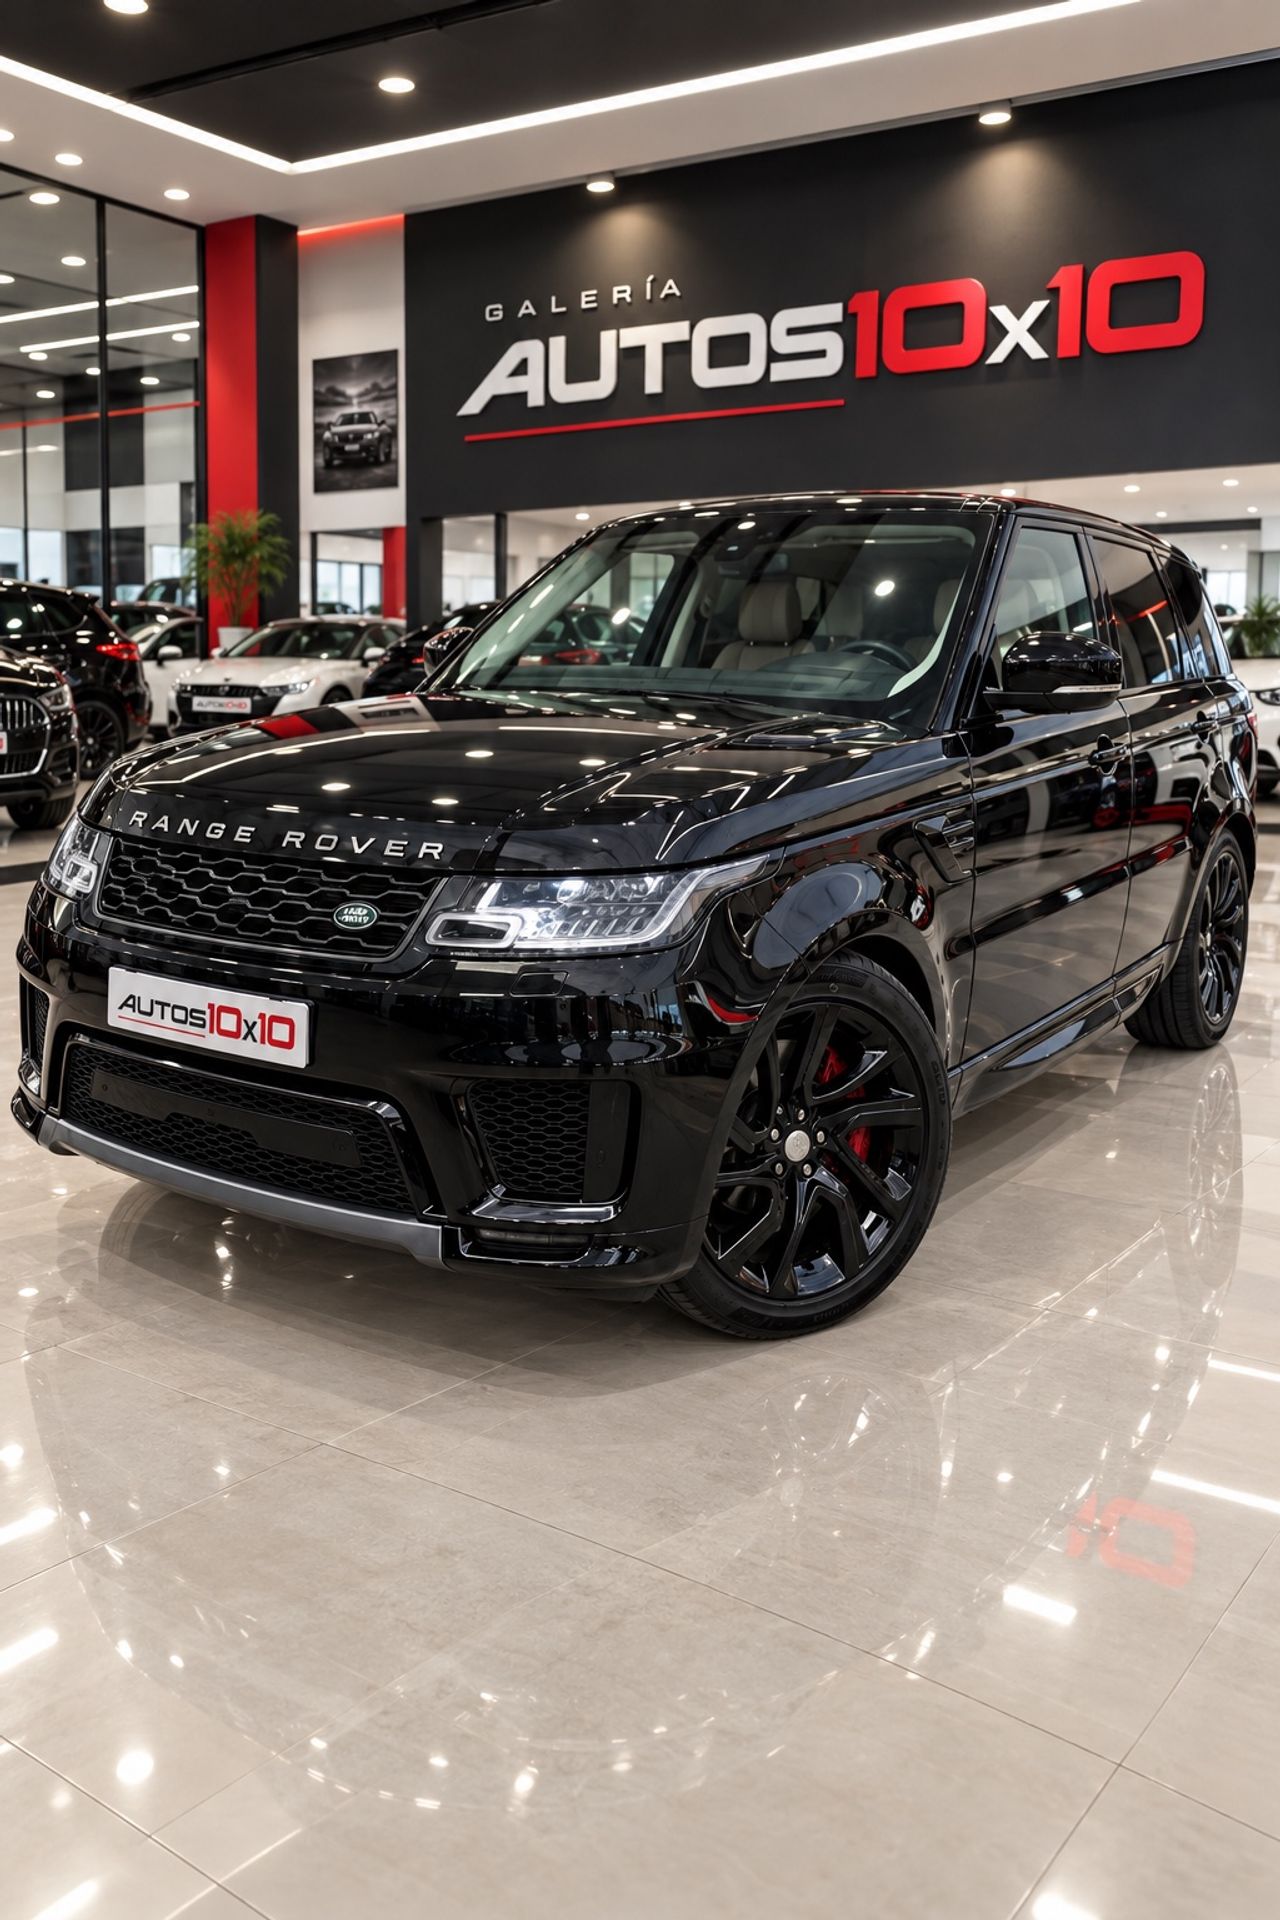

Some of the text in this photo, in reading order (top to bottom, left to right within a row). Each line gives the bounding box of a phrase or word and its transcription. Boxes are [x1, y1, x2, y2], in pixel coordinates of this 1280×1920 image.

[485, 274, 681, 321] GALERÍA
[456, 250, 1205, 417] AUTOS10x10
[129, 811, 444, 859] RANGE ROVER
[118, 993, 295, 1050] AUTOS10x10
